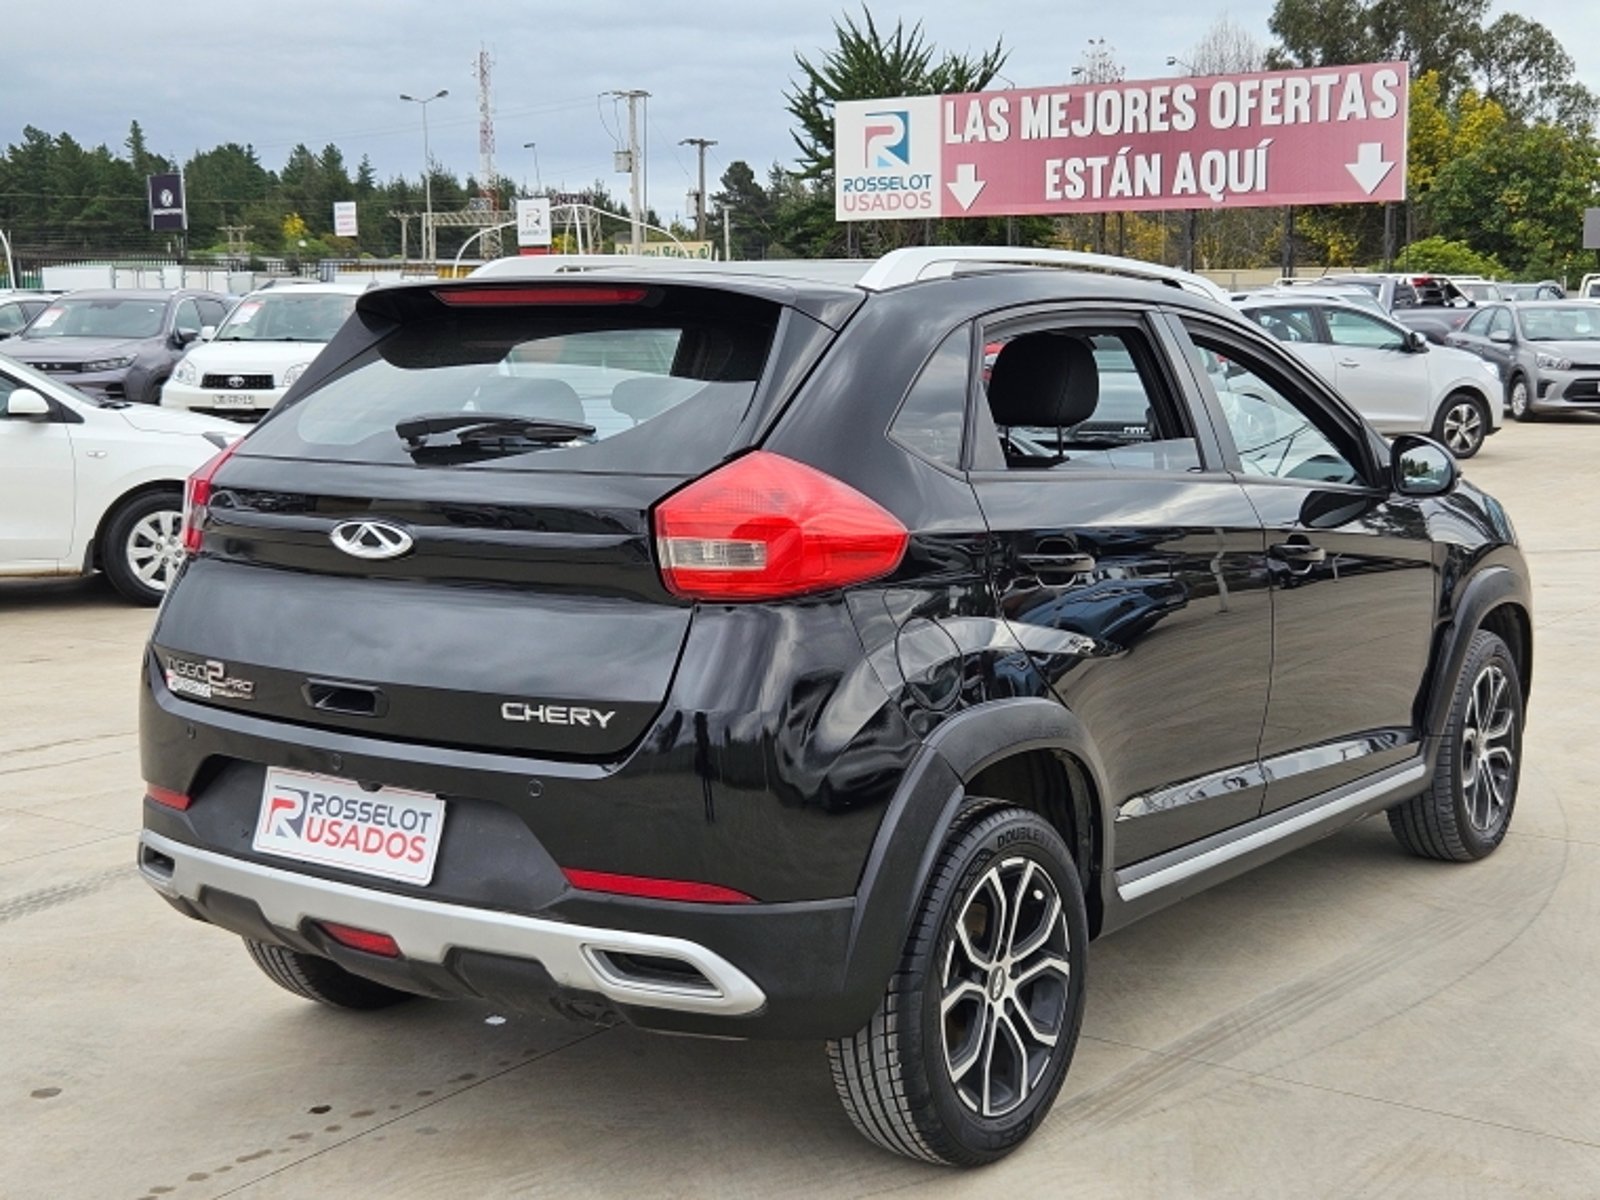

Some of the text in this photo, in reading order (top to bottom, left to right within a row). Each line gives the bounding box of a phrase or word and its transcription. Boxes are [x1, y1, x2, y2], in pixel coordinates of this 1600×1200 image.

[945, 68, 1400, 144] LAS MEJORES OFERTAS
[843, 174, 933, 193] ROSSELOT
[1045, 137, 1275, 203] ESTÁN AQUÍ
[843, 191, 933, 212] USADOS
[501, 702, 616, 729] CHERY
[310, 793, 432, 834] ROSSELOT
[306, 816, 427, 864] USADOS
